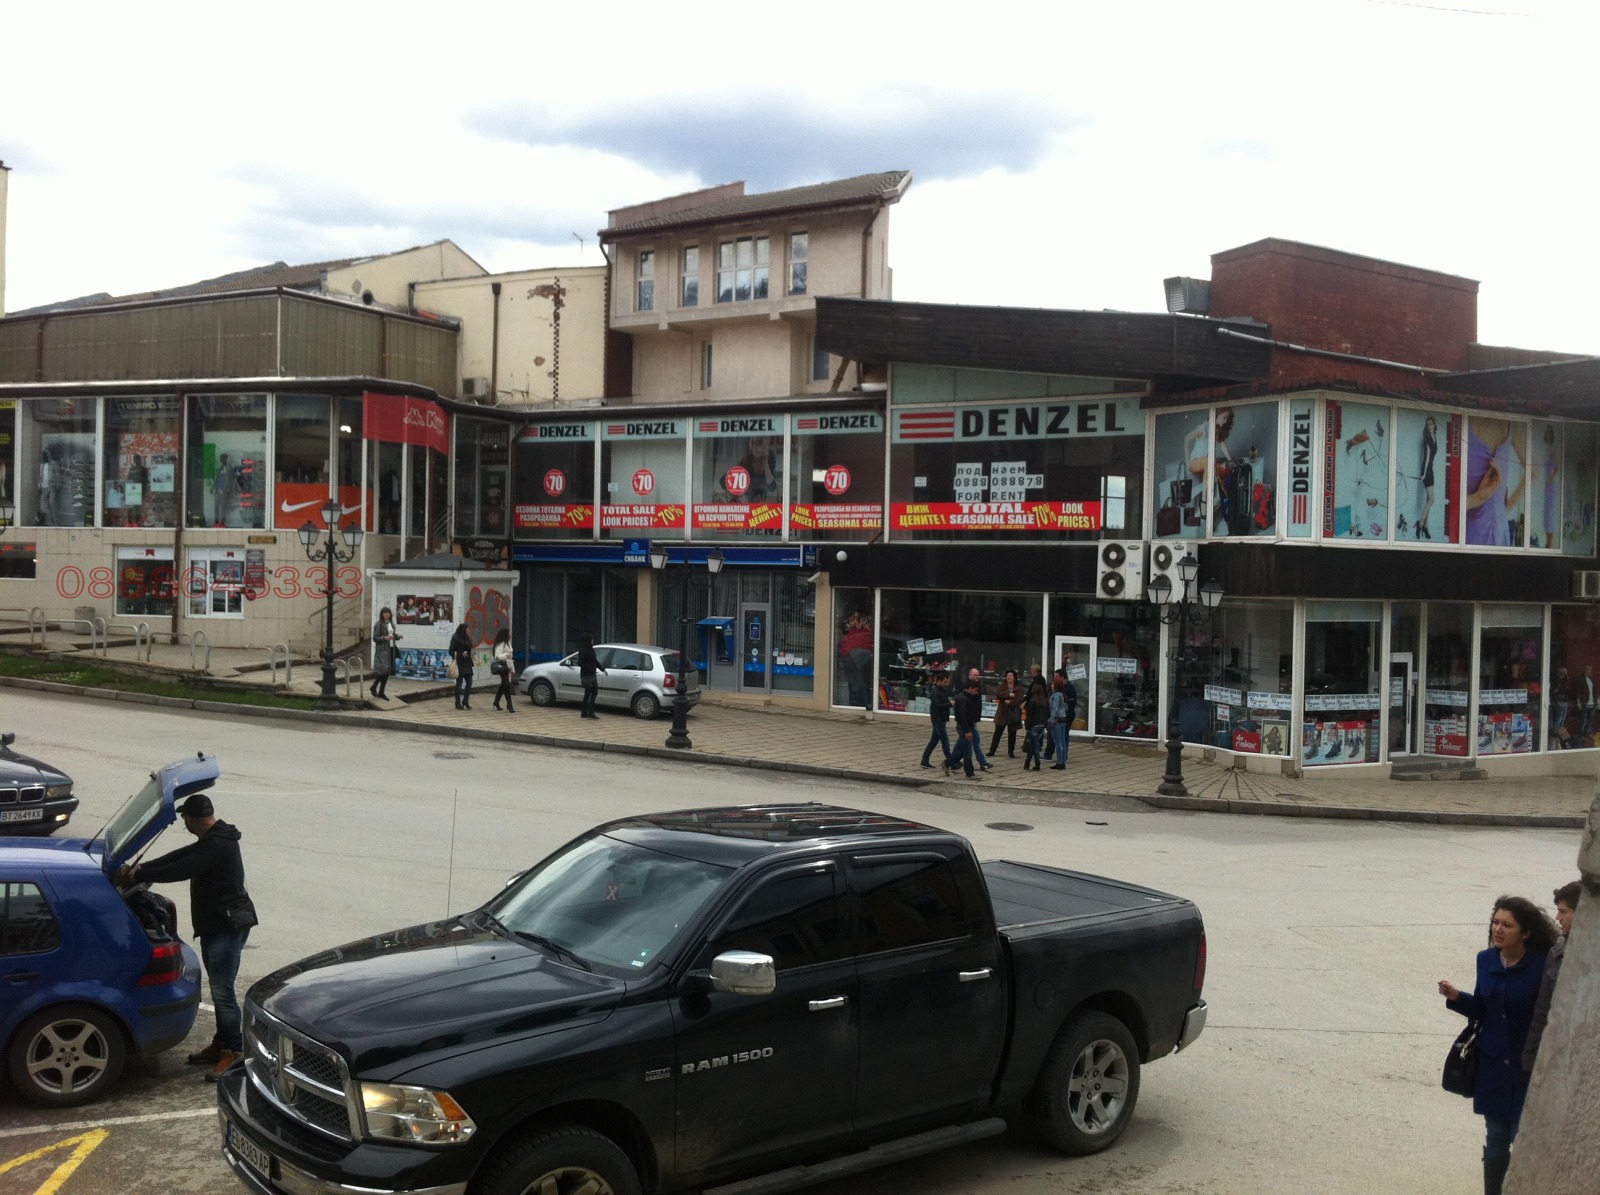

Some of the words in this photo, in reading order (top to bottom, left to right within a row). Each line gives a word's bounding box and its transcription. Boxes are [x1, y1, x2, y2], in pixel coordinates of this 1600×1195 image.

[721, 419, 775, 432] DENZEL
[819, 415, 878, 429] DENZEL
[962, 402, 1125, 438] DENZEL
[539, 425, 587, 438] DENZEL
[627, 422, 678, 435] DENZEL
[1292, 408, 1310, 493] DENZEL
[957, 466, 981, 476] под
[992, 465, 1025, 475] наем
[955, 477, 987, 487] 0888
[992, 475, 1042, 487] 088878
[957, 491, 981, 501] FOR
[991, 491, 1024, 501] RENT
[515, 505, 540, 514] СЕЗОННА
[602, 505, 631, 515] TOTAL
[633, 505, 656, 514] SALE
[795, 505, 810, 517] LOOK
[906, 504, 929, 514] ВИЖ
[959, 503, 1025, 514] TOTAL
[1062, 503, 1083, 514] LOOK
[566, 505, 593, 526] 70%
[603, 516, 621, 526] LOOK
[622, 516, 649, 526] PRICES
[657, 504, 684, 526] 70%
[698, 514, 705, 522] НА
[748, 508, 779, 528] ЦЕНИТЕ
[791, 512, 813, 527] PRICES
[899, 514, 940, 527] ЦЕНИТЕ
[949, 514, 1006, 524] SEASONAL
[1007, 514, 1034, 524] SALE
[1032, 502, 1057, 528] 70%
[818, 519, 860, 528] SEASONAL
[862, 519, 882, 528] SALE
[1057, 515, 1090, 528] PRICES
[624, 555, 646, 563] СИБАНК
[681, 1055, 729, 1074] RAM
[732, 1046, 774, 1064] 1500
